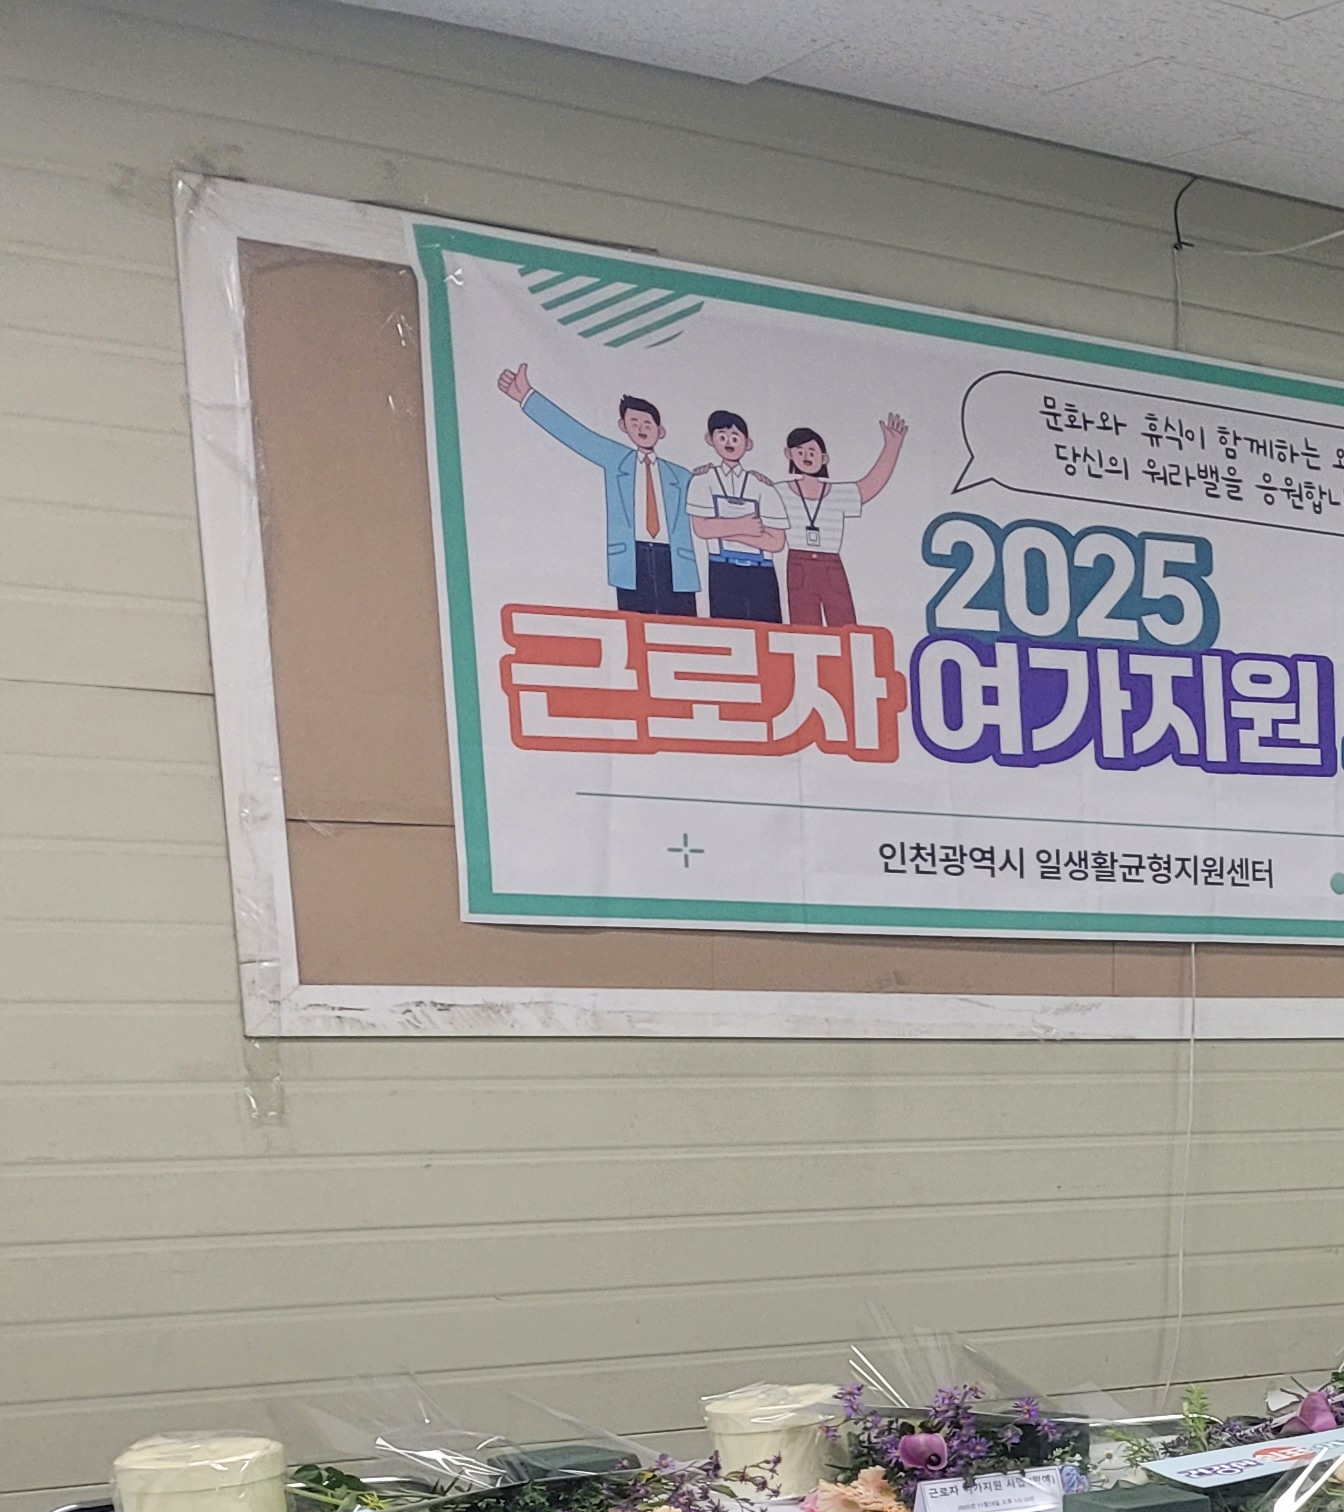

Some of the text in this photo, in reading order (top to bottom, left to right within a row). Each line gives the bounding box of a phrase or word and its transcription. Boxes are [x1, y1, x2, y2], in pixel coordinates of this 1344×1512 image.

[1039, 395, 1128, 436] 문화와
[1141, 412, 1206, 451] 휴식이
[1216, 426, 1321, 471] 함께하는
[1055, 443, 1129, 480] 당신의
[1142, 458, 1244, 501] 워라밸을
[924, 519, 1212, 644] 2025
[505, 607, 898, 757] 근로자
[914, 637, 1328, 770] 여가지원
[877, 841, 1275, 889] 인천광역시 일생활균형지원센터
[928, 1486, 959, 1499] 근로자
